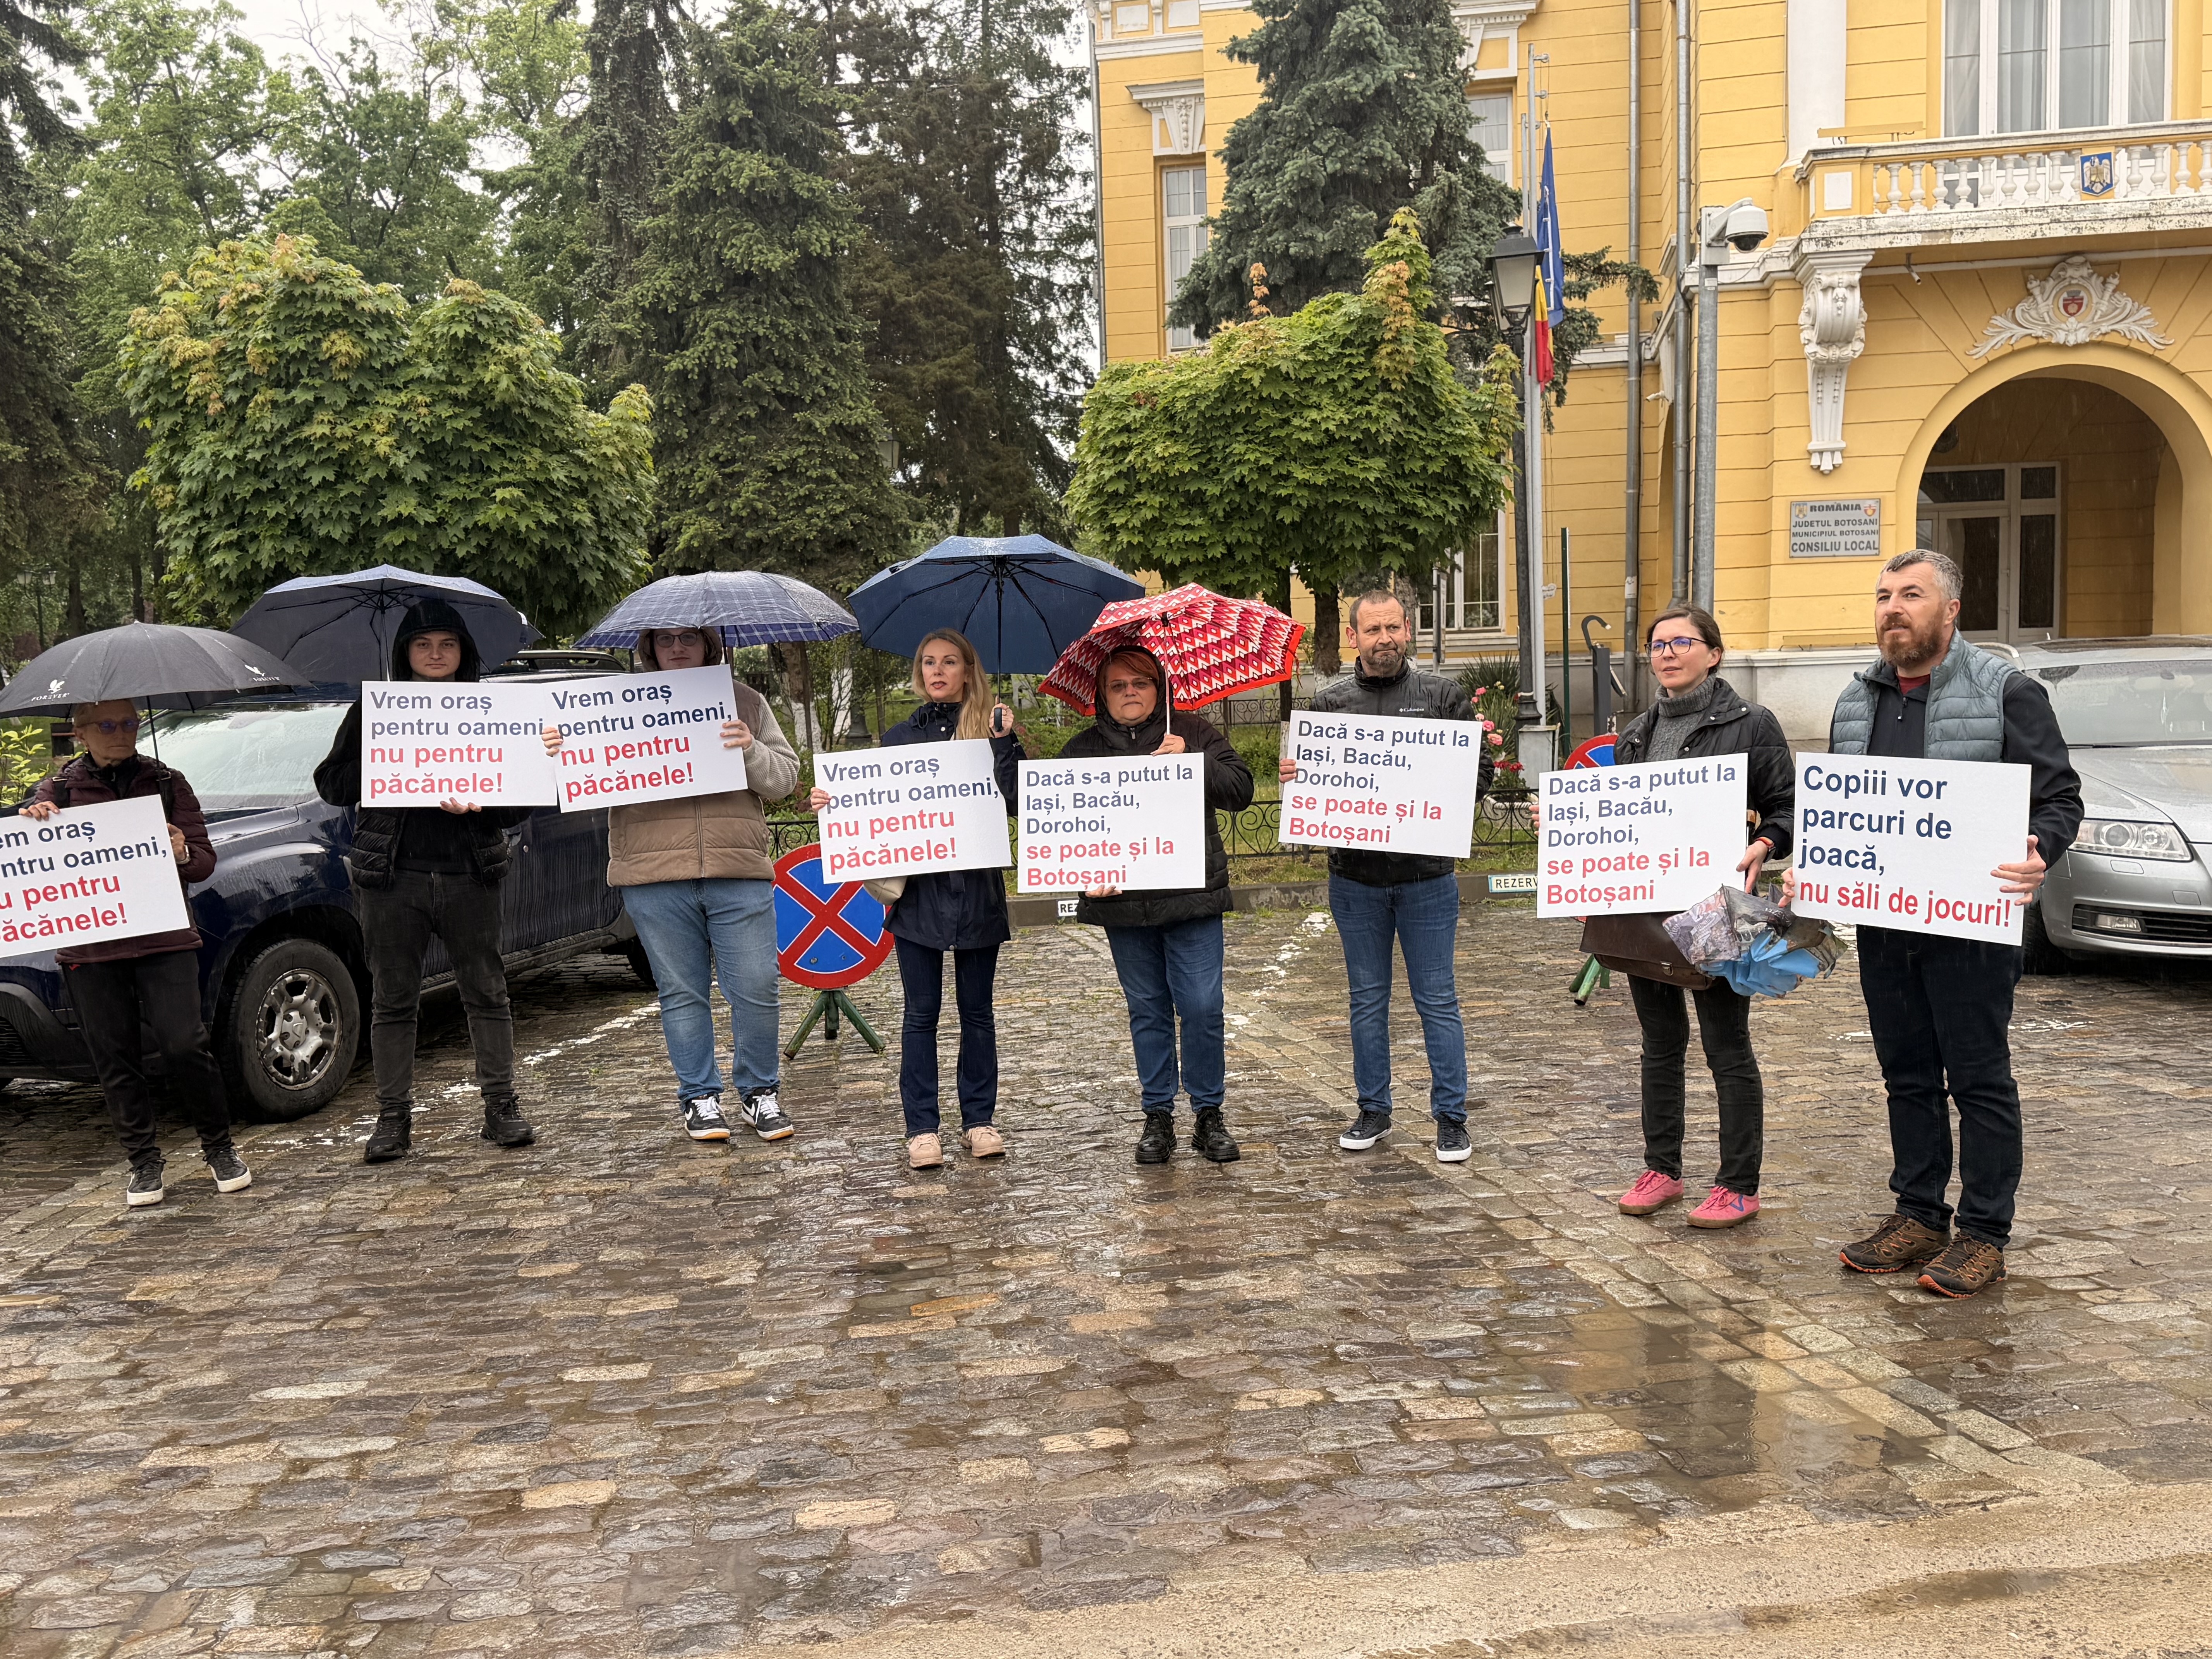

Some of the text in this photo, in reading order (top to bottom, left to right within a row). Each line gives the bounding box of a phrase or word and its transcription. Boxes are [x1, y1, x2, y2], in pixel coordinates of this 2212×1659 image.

[1791, 541, 1878, 552] CONSILIU LOCAL
[370, 692, 492, 715] Vrem oraș
[551, 685, 672, 709] Vrem oraș
[372, 719, 448, 739] pentru
[557, 702, 732, 739] pentru oameni,
[1298, 721, 1468, 747] Dacă s-a putut la
[371, 744, 502, 768] nu pentru
[561, 736, 690, 766] nu pentru
[1297, 744, 1411, 770] Iași, Bacău,
[565, 763, 694, 802] păcănele!
[823, 757, 939, 781] Vrem oraș
[1027, 764, 1192, 787] Dacă s-a putut la
[1295, 768, 1378, 792] Dorohoi,
[1550, 764, 1735, 795] Dacă s-a putut la
[1804, 766, 1947, 799] Copiii vor
[371, 773, 501, 799] păcănele!
[826, 778, 998, 814] pentru oameni,
[1027, 791, 1139, 815] Iași, Bacău,
[1292, 796, 1441, 823] se poate și la
[1549, 796, 1672, 826] Iași, Bacău,
[38, 822, 95, 842] oraș
[828, 809, 954, 839] nu pentru
[1027, 816, 1110, 834] Dorohoi,
[1290, 818, 1390, 846] Botoșani
[1549, 824, 1638, 847] Dorohoi,
[1803, 809, 1951, 839] parcuri de
[64, 836, 166, 867] oameni,
[830, 838, 956, 875] păcănele!
[1027, 837, 1173, 862] se poate și la
[1547, 847, 1709, 878] se poate și la
[1798, 839, 1884, 876] joacă,
[1028, 865, 1125, 889] Botoșani
[22, 876, 120, 911] pentru
[1547, 880, 1654, 908] Botoșani
[1800, 881, 2010, 927] nu săli de jocuri!
[0, 902, 127, 943] ăcănele!
